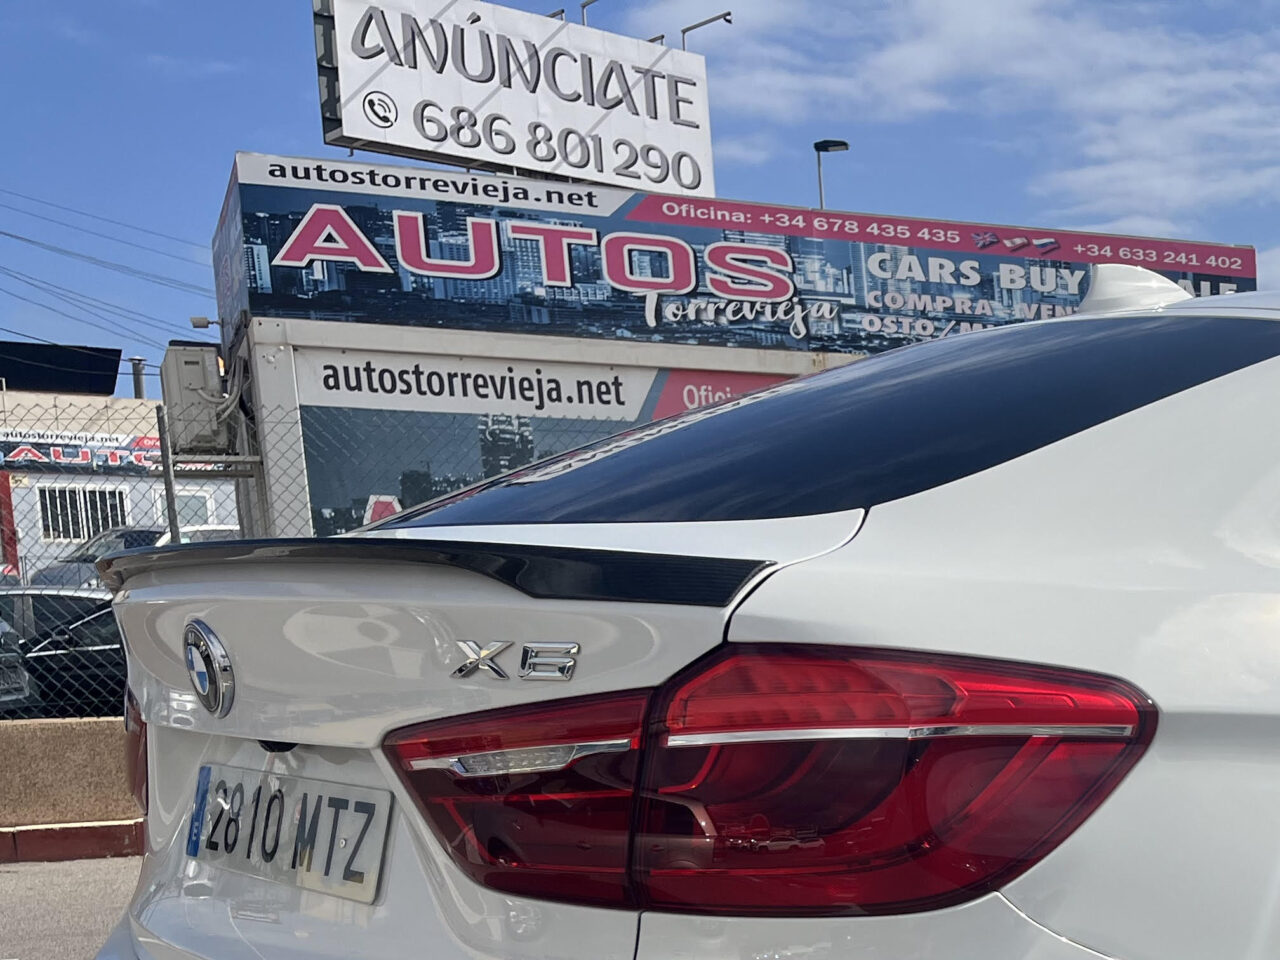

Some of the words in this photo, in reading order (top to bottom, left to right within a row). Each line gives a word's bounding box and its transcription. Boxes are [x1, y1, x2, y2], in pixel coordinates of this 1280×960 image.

[351, 6, 700, 129] ANÚNCIATE
[413, 100, 516, 155] 686
[527, 121, 604, 173] 801
[613, 138, 702, 190] 290
[267, 161, 599, 208] autostorrevieja.net
[662, 202, 752, 224] Oficina:
[760, 213, 806, 229] +34
[813, 217, 859, 234] 678
[866, 223, 910, 239] 435
[917, 227, 961, 244] 435
[271, 202, 795, 302] AUTOS
[867, 252, 981, 287] CARS
[999, 263, 1086, 295] BUY
[1073, 244, 1113, 258] +34
[1118, 247, 1158, 262] 633
[1163, 251, 1201, 266] 241
[1205, 255, 1243, 270] 402
[632, 290, 839, 340] Torrevieja
[861, 315, 935, 337] OSTO
[866, 291, 993, 317] COMPRA
[322, 361, 626, 411] autostorrevieja.net
[449, 639, 581, 681] X6
[205, 779, 285, 864] 2810
[291, 792, 376, 885] MTZ
